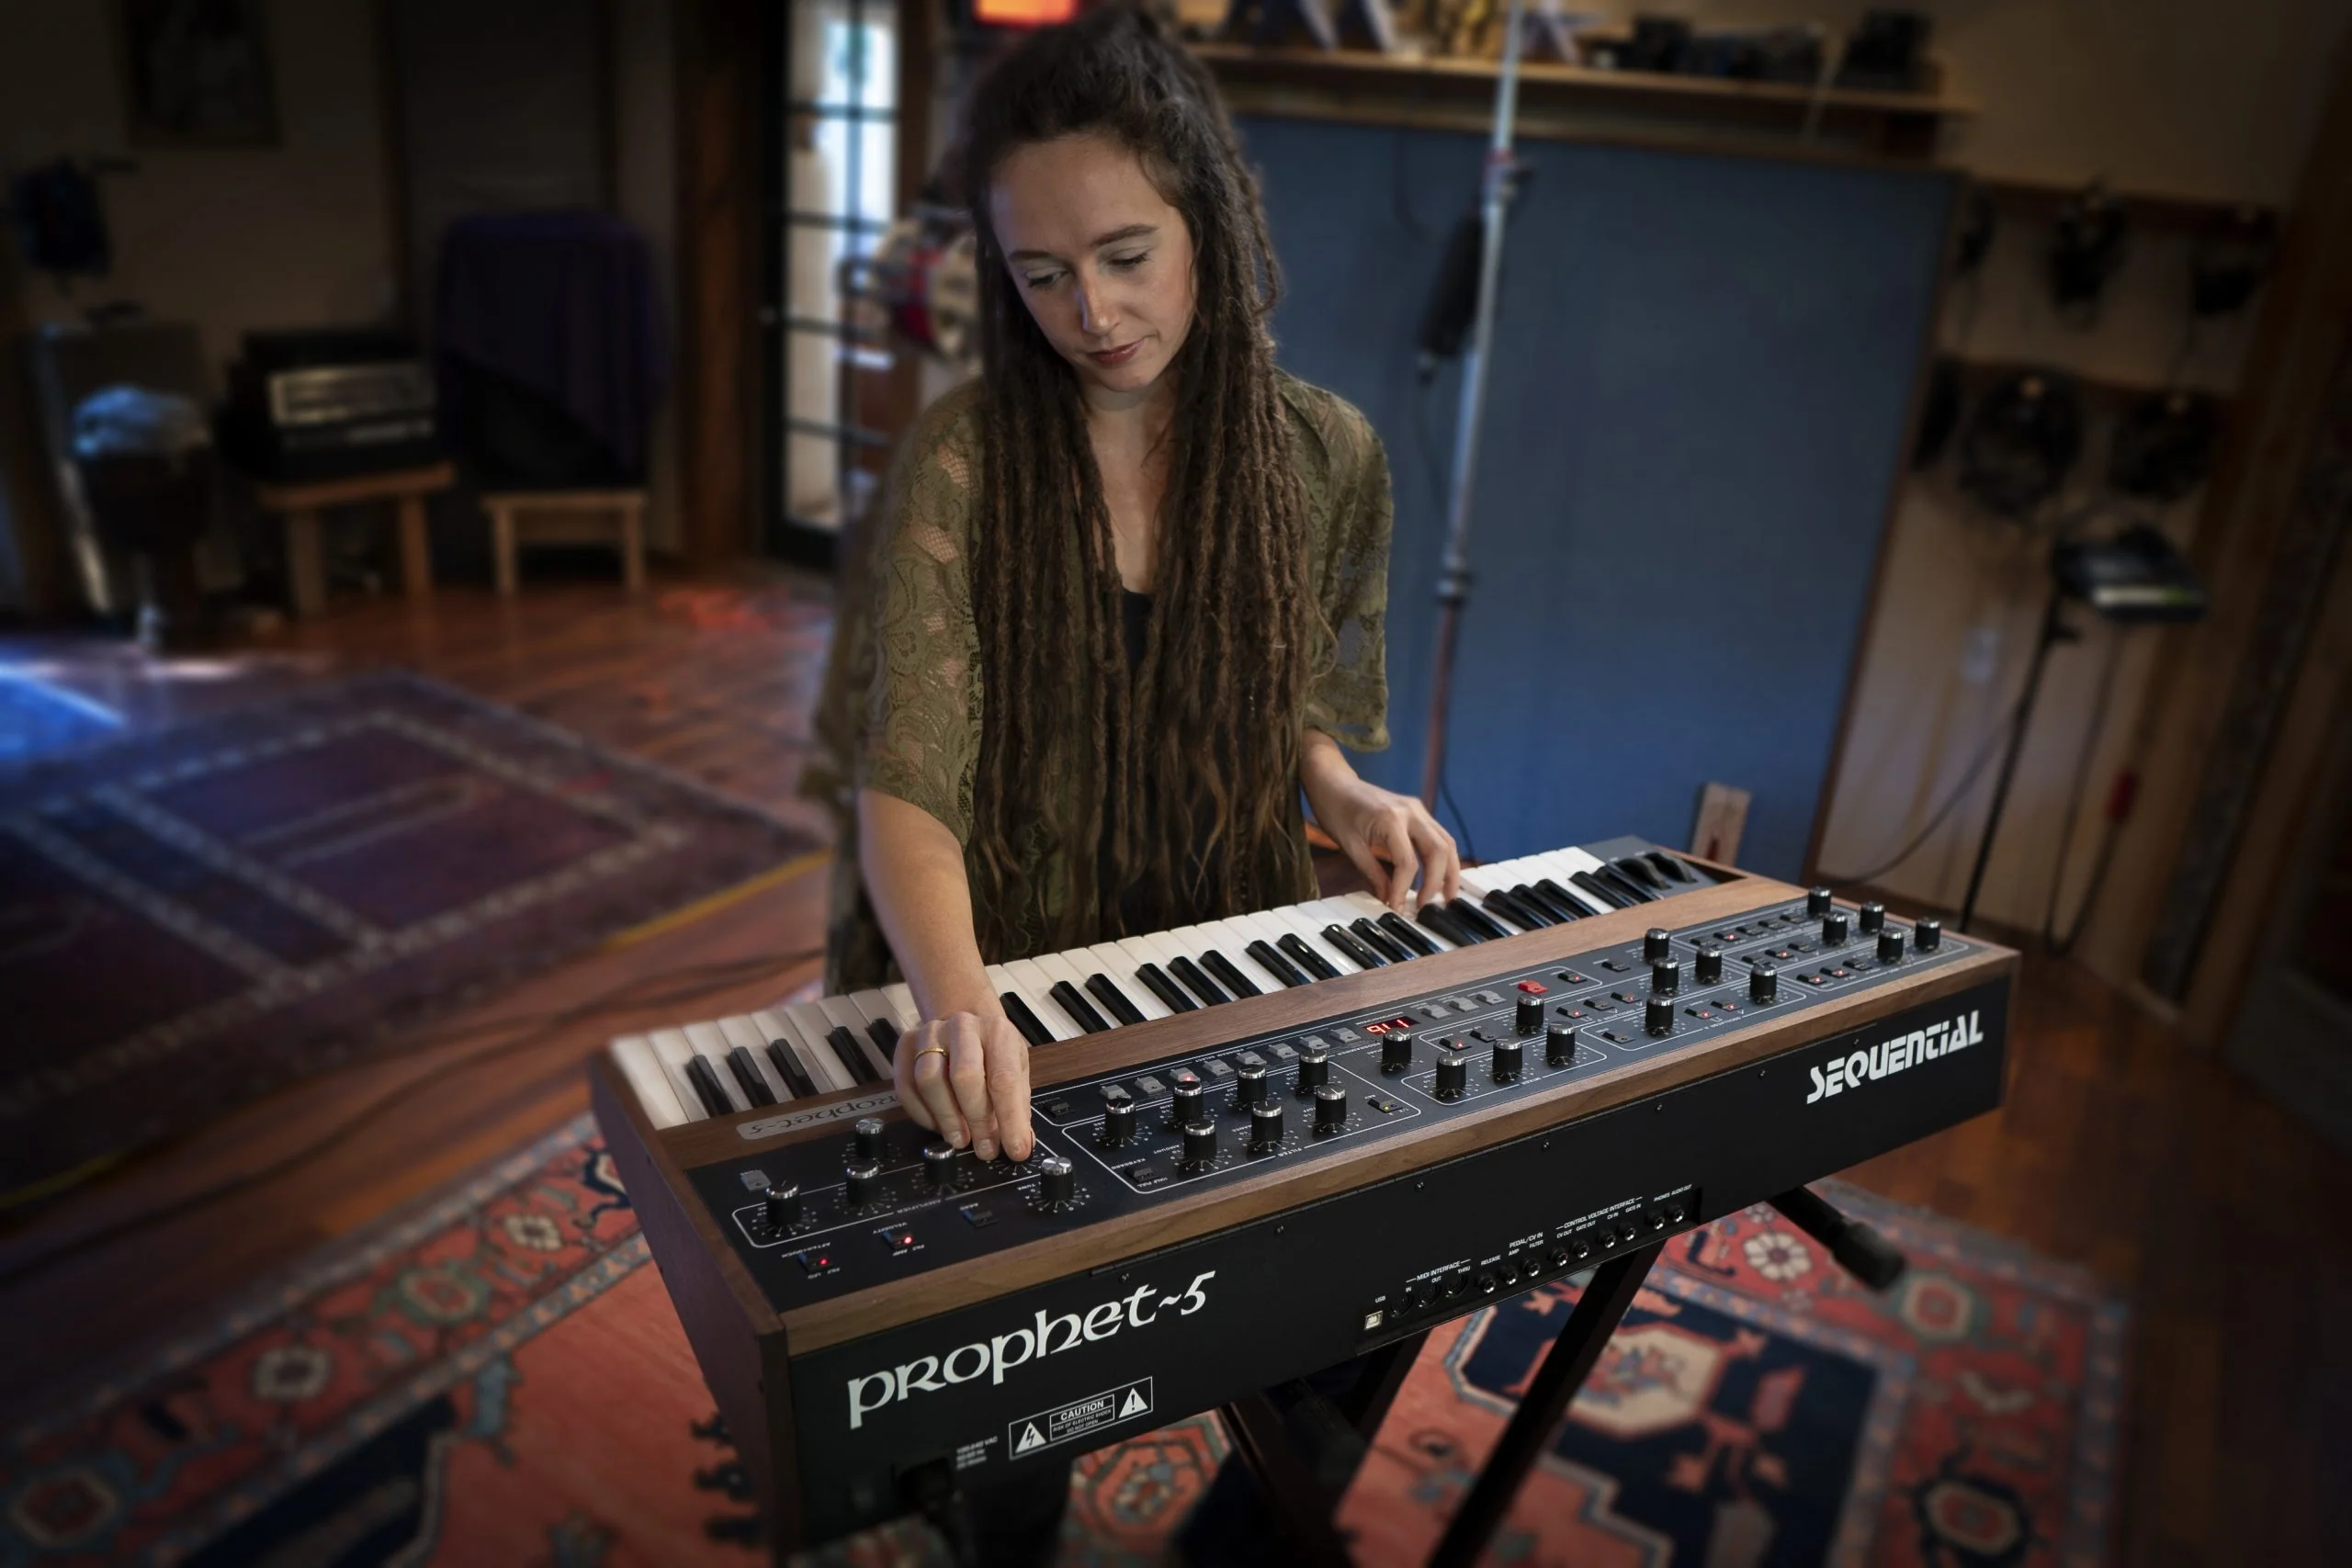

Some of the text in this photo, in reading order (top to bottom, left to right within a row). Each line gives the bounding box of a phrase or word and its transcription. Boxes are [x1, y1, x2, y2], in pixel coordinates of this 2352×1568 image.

[1806, 1010, 1984, 1104] SEQUENTIAL
[1654, 1191, 1669, 1202] PHONES
[1564, 1197, 1634, 1229] CONTROL VOLTAGE INTERFACE
[1564, 1228, 1572, 1236] OUT
[1576, 1224, 1586, 1232] GATE
[1529, 1238, 1544, 1248] FILTER
[1508, 1247, 1519, 1257] AMP
[1480, 1254, 1500, 1267] RELEASE
[1417, 1259, 1460, 1281] MIDI INTERFACE
[1458, 1264, 1470, 1274] THRU
[1431, 1275, 1441, 1283] OUT
[1374, 1294, 1385, 1303] USB
[1060, 1400, 1103, 1421] CAUTION
[1053, 1424, 1063, 1432] RISK
[1072, 1414, 1093, 1426] ELECTRIC
[1095, 1408, 1111, 1417] SHOCK
[1073, 1423, 1084, 1431] NOT
[1085, 1418, 1098, 1427] OPEN
